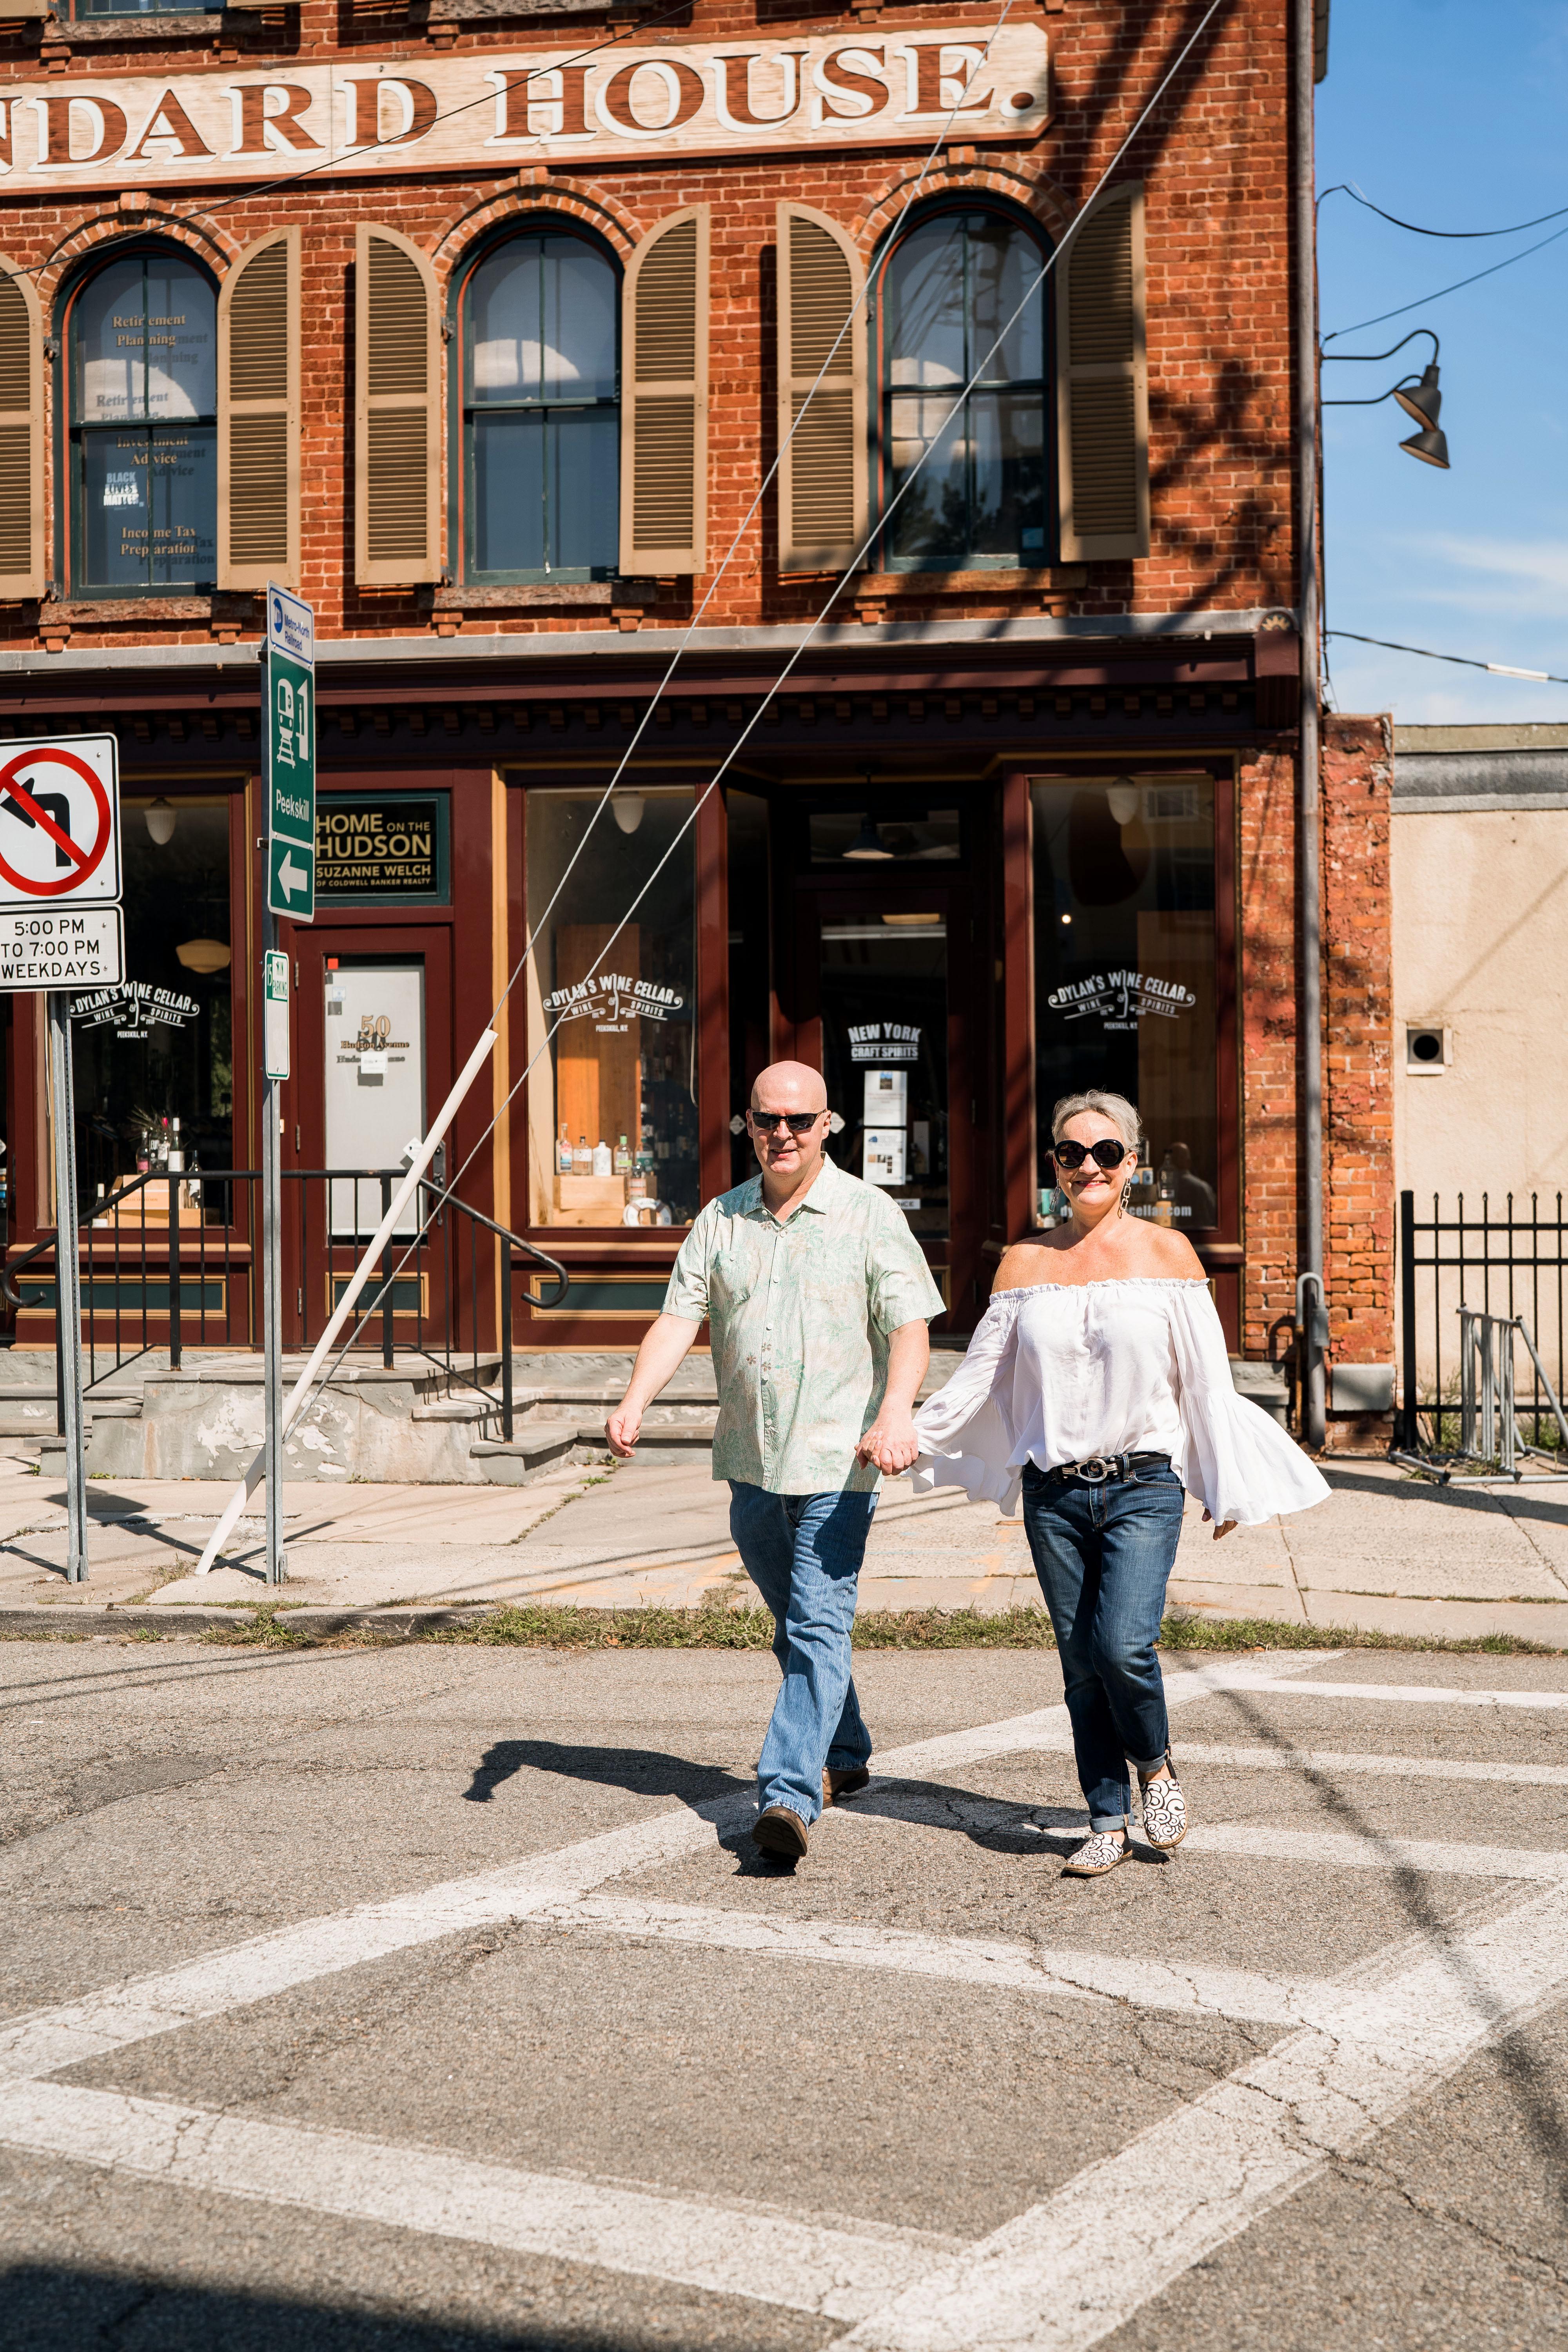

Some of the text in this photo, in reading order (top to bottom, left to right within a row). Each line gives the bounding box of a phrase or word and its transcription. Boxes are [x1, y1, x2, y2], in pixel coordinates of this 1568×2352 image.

[0, 40, 1037, 174] DARD HOUSE.
[112, 314, 186, 329] Retirement
[116, 333, 177, 348] Planning
[130, 452, 178, 466] Advice
[107, 472, 136, 483] BLACK
[122, 527, 172, 539] Income
[284, 614, 309, 639] Metro-North
[285, 631, 302, 651] Railroad
[276, 789, 309, 822] Peekskill
[316, 813, 430, 834] HOME ON THE
[316, 834, 430, 858] HUDSON
[316, 864, 430, 878] SUZANNE WELCH
[15, 918, 84, 936] 5:00 PM
[1, 939, 99, 958] TO 7:00 PM
[1, 961, 100, 979] WEEKDAYS
[267, 963, 272, 987] 15
[273, 980, 287, 997] PARKING
[599, 973, 633, 993] WINE
[633, 980, 674, 1004] CELLAR
[1057, 969, 1186, 1003] DYLAN'S WINE CELLAR
[75, 981, 192, 1013] DYLAN'S WINE CELLAR
[1140, 997, 1176, 1014] SPIRITS
[93, 1008, 115, 1022] WINE
[150, 1007, 182, 1024] SPIRITS
[570, 1001, 593, 1016] WINE
[630, 1000, 664, 1016] SPIRITS
[360, 1015, 391, 1038] 50
[848, 1022, 922, 1044] NEW YORK
[340, 1041, 375, 1049] Hudson
[851, 1046, 918, 1058] CRAFT SPIRITS
